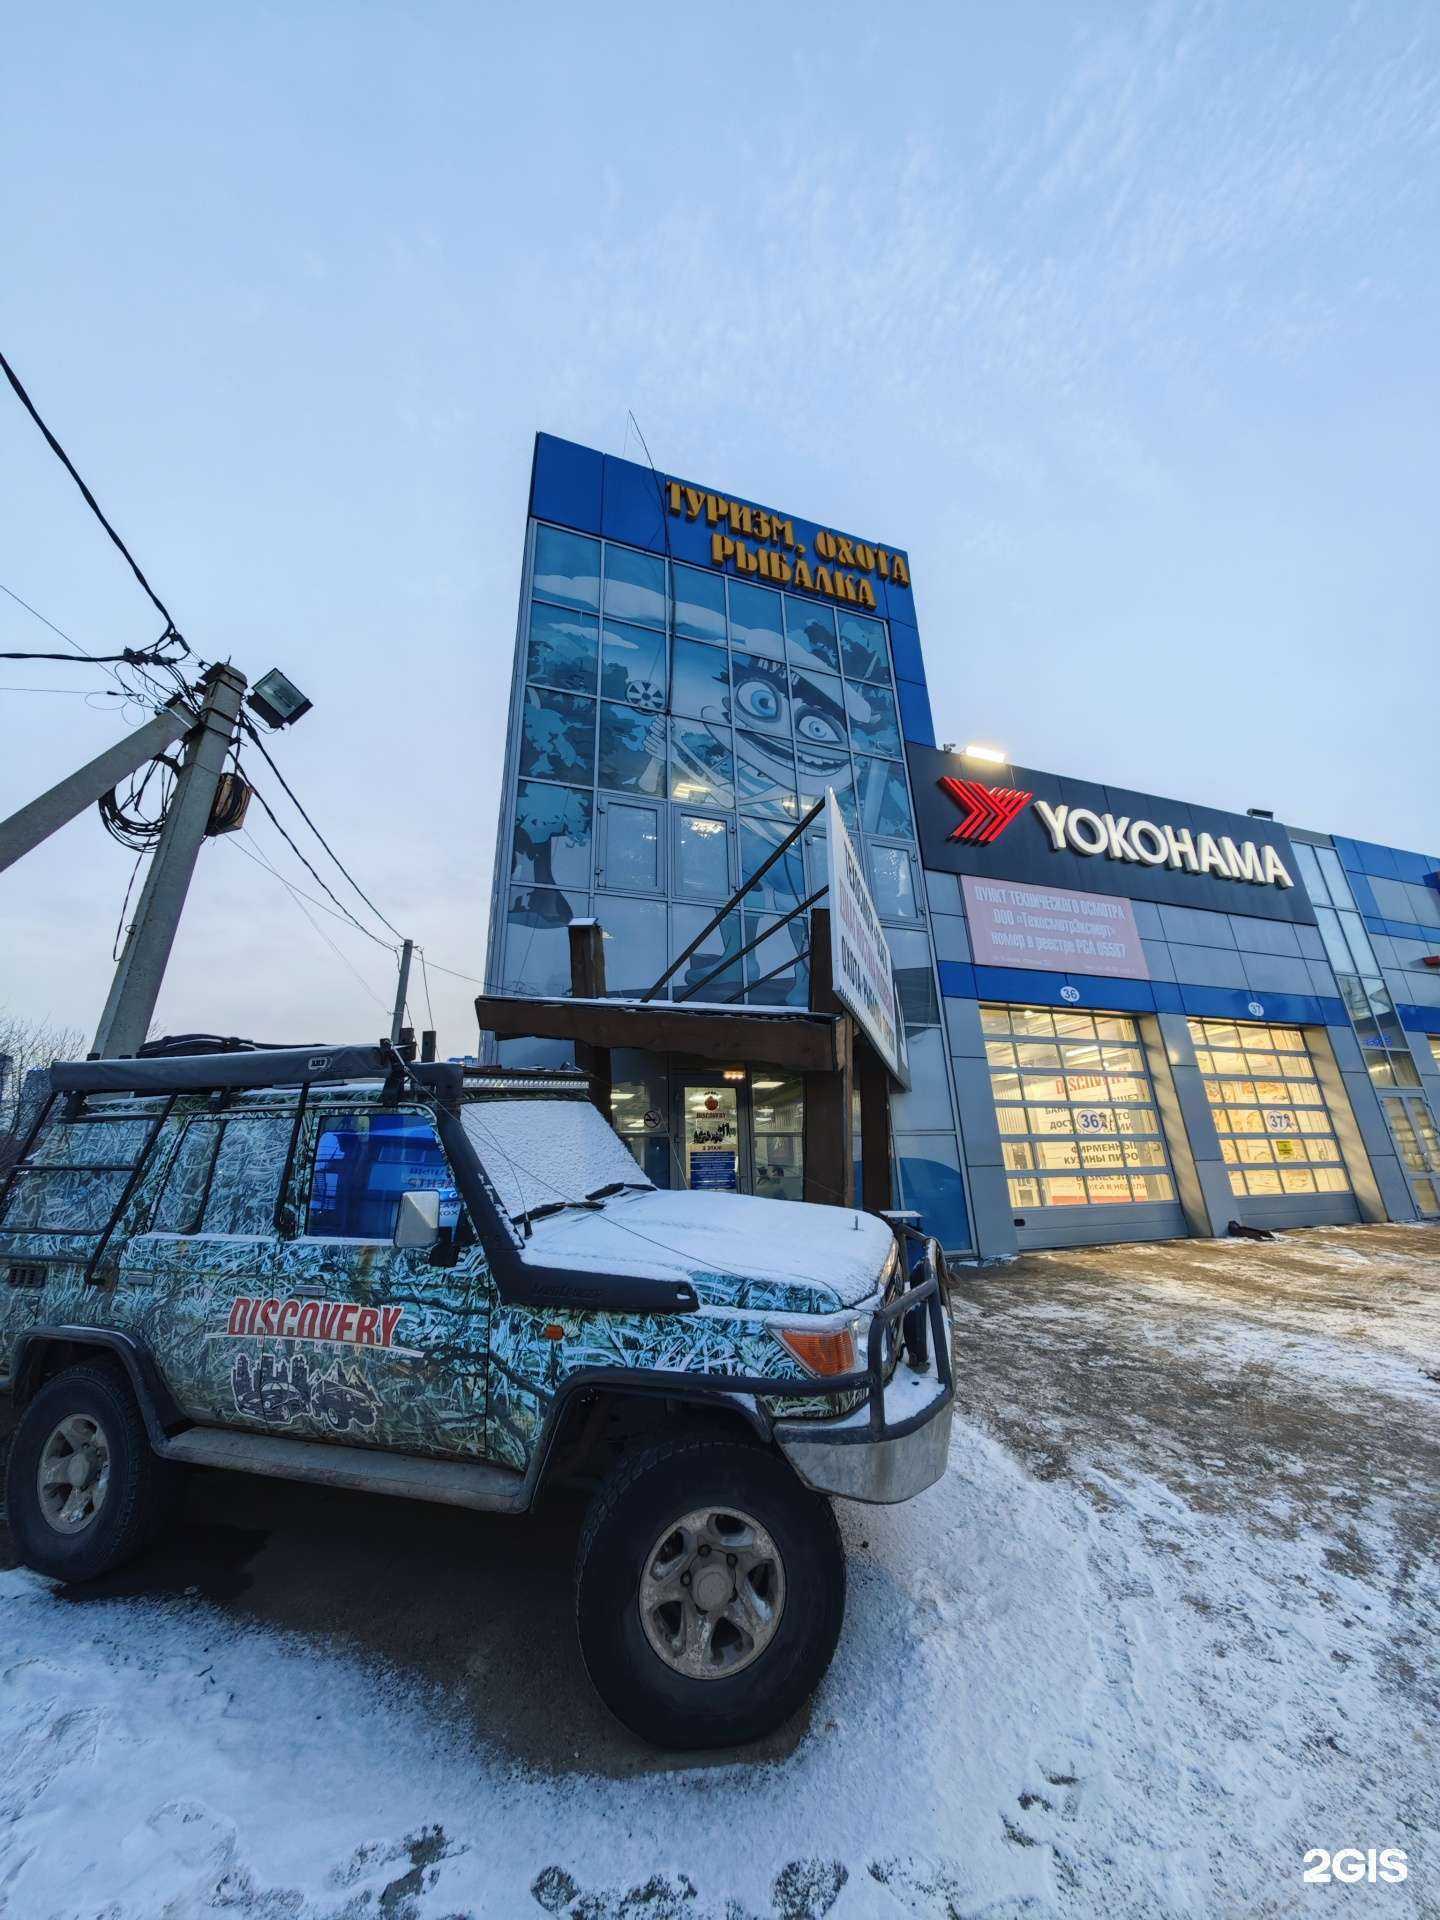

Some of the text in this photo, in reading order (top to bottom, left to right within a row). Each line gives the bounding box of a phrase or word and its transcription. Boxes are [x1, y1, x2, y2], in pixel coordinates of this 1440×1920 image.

[667, 480, 911, 588] ТУРИЗМ, ОХОТА
[711, 531, 877, 610] РЫБАЛКА
[1034, 799, 1295, 889] YOKOHAMA
[974, 885, 1006, 902] ПУНКТ
[1081, 900, 1126, 921] ОСМОТРА
[1064, 988, 1078, 1000] 36
[1249, 1004, 1262, 1015] 37
[1081, 1114, 1100, 1129] 36
[1270, 1115, 1284, 1128] 37
[228, 1297, 403, 1348] DISCOVERY
